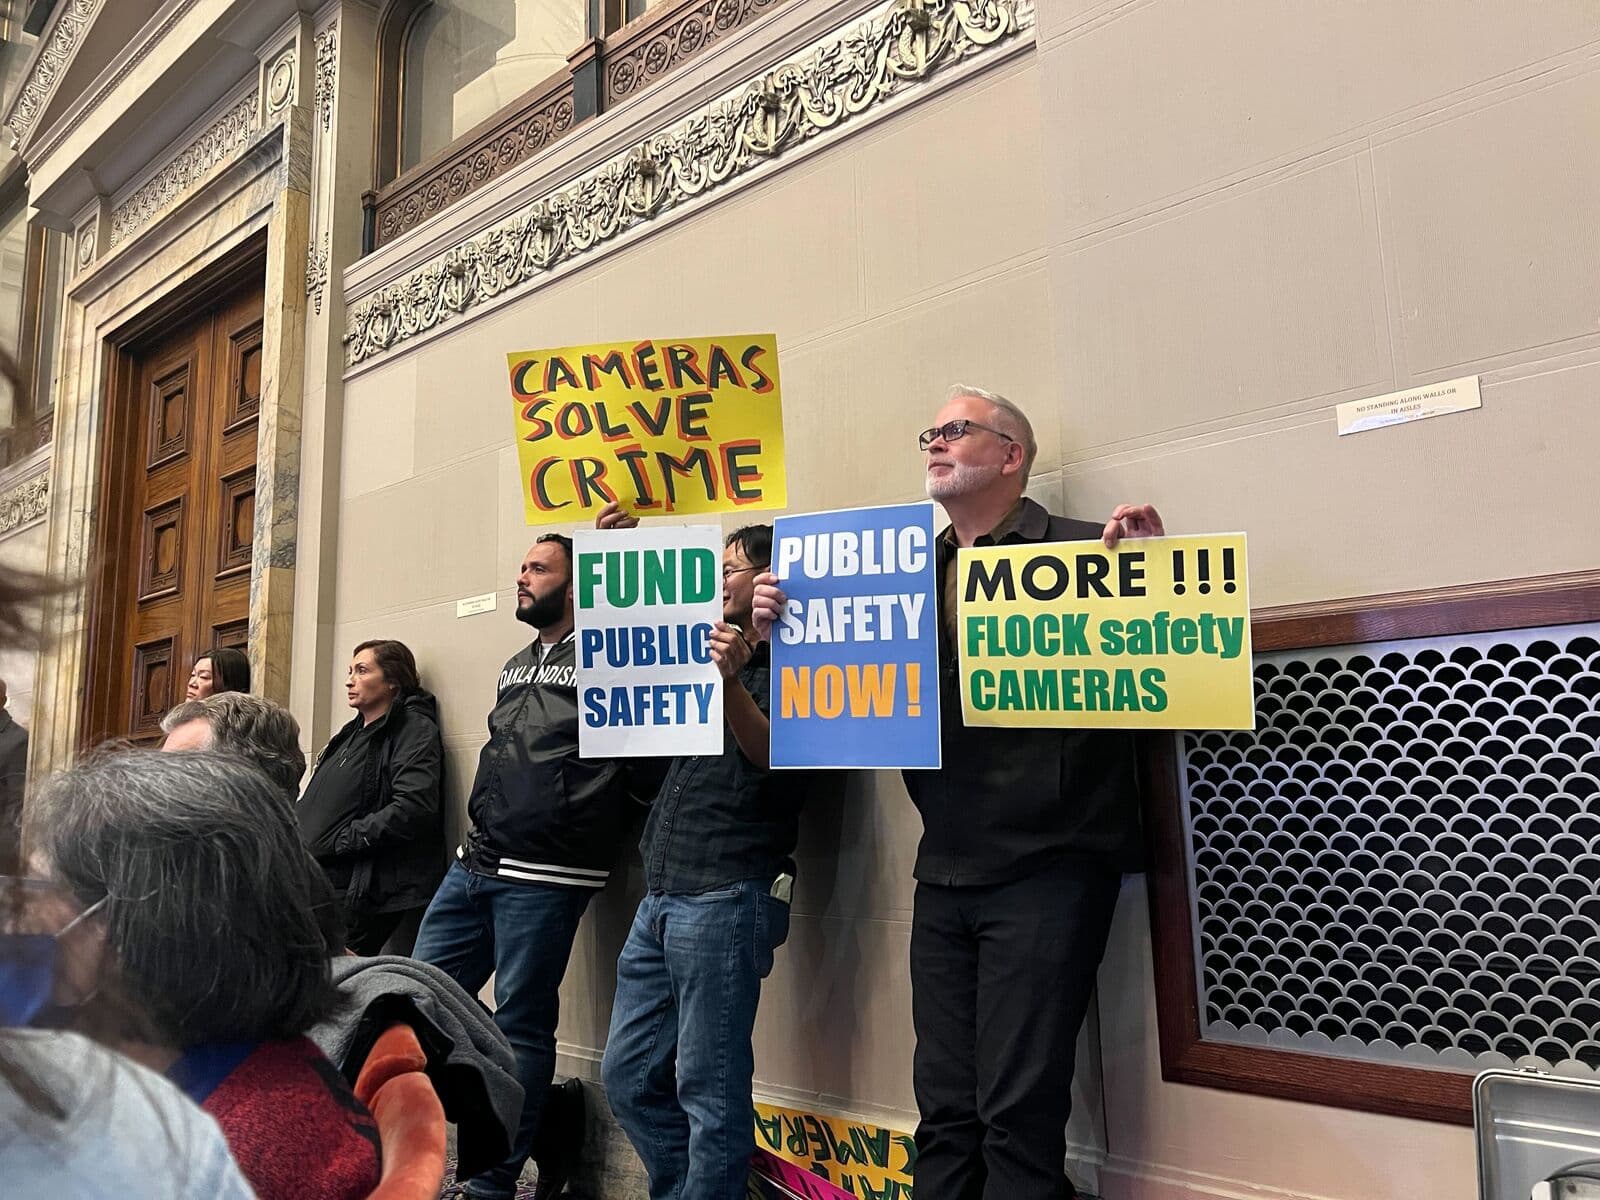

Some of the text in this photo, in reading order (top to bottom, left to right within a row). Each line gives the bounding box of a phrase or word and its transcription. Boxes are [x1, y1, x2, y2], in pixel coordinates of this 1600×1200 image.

[510, 340, 774, 402] CAMERAS
[521, 391, 713, 442] SOLVE
[1366, 400, 1399, 411] STANDING
[1400, 395, 1422, 404] ALONG
[1423, 390, 1446, 399] WALLS
[1399, 404, 1421, 413] AISLES
[530, 439, 763, 512] CRIME
[578, 547, 716, 609] FUND
[777, 526, 927, 580] PUBLIC
[964, 551, 1146, 602] MORE
[779, 593, 927, 645] SAFETY
[966, 611, 1244, 659] FLOCK safety
[582, 622, 714, 669] PUBLIC
[583, 682, 715, 728] SAFETY
[970, 668, 1168, 713] CAMERAS
